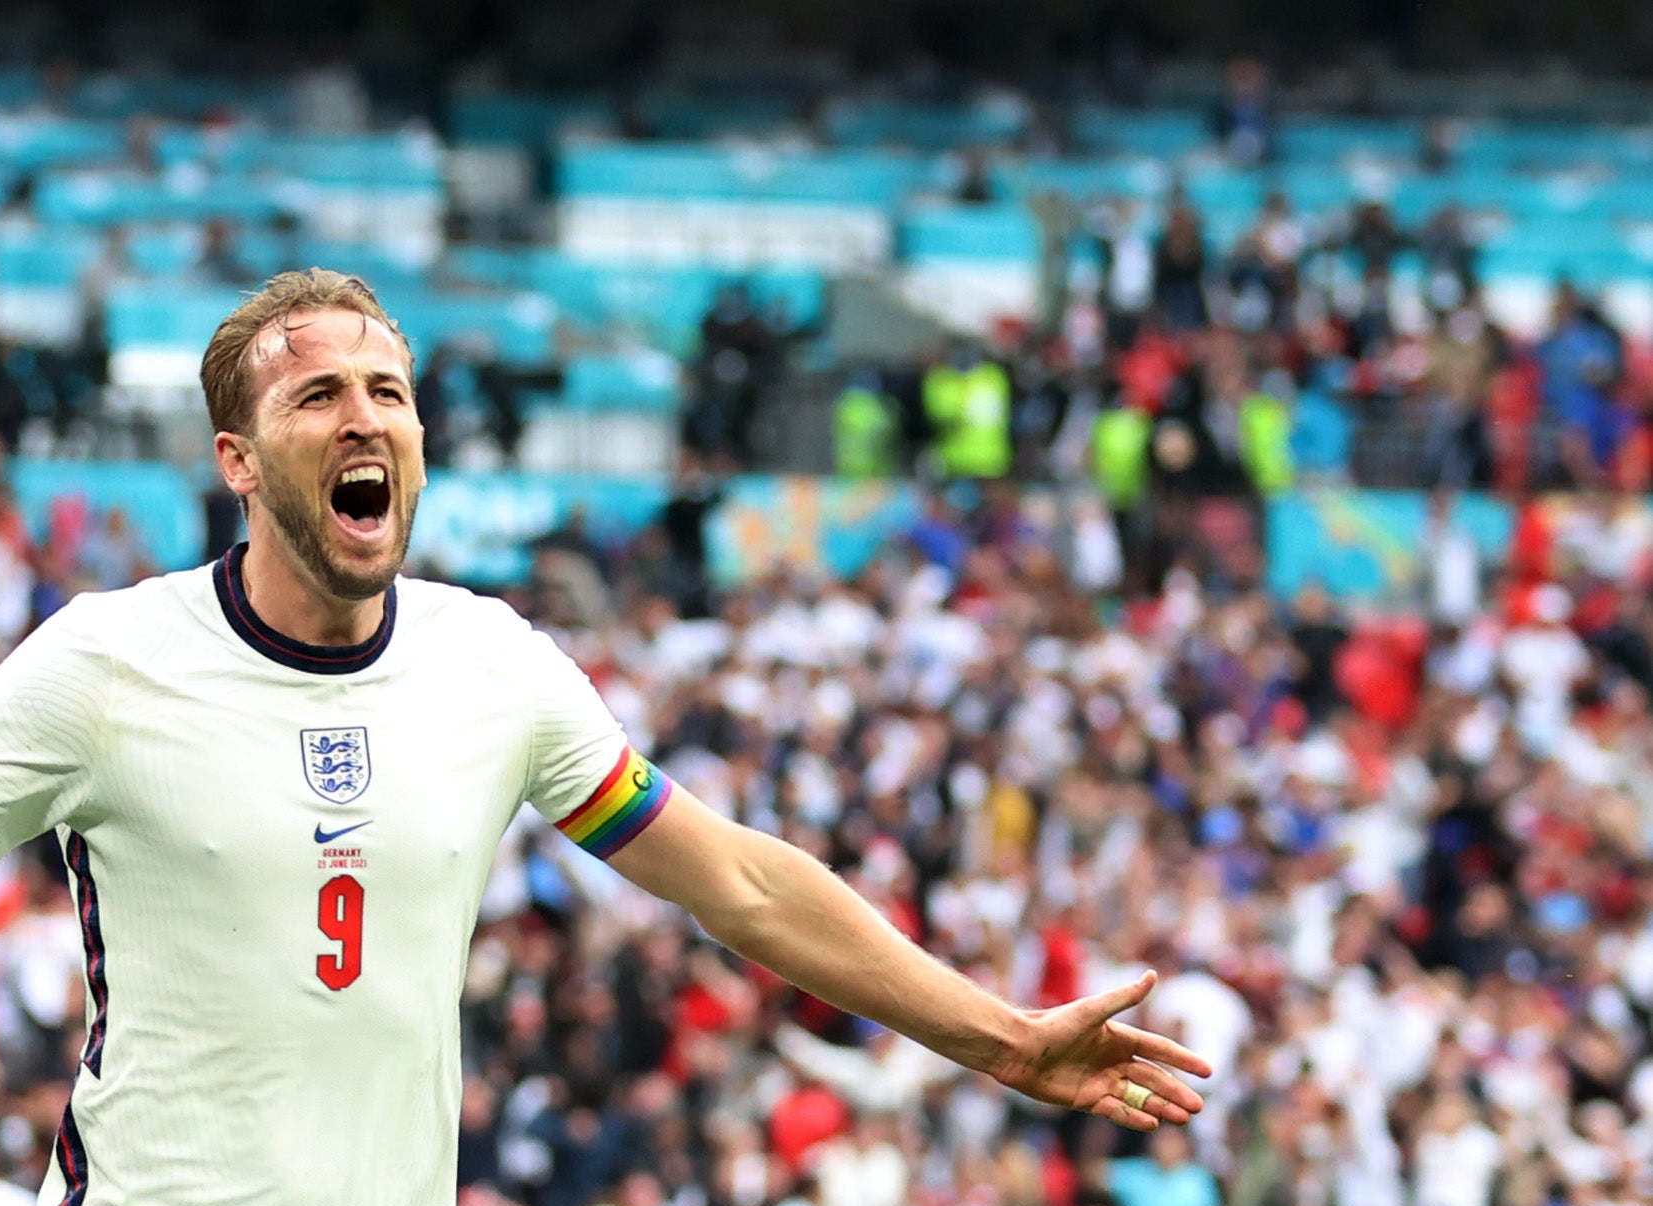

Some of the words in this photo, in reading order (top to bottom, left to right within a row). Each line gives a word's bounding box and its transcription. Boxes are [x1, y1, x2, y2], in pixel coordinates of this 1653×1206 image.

[323, 848, 361, 858] GERMANY
[329, 859, 348, 869] JUNE
[350, 858, 367, 868] 2021
[316, 874, 364, 991] 9
